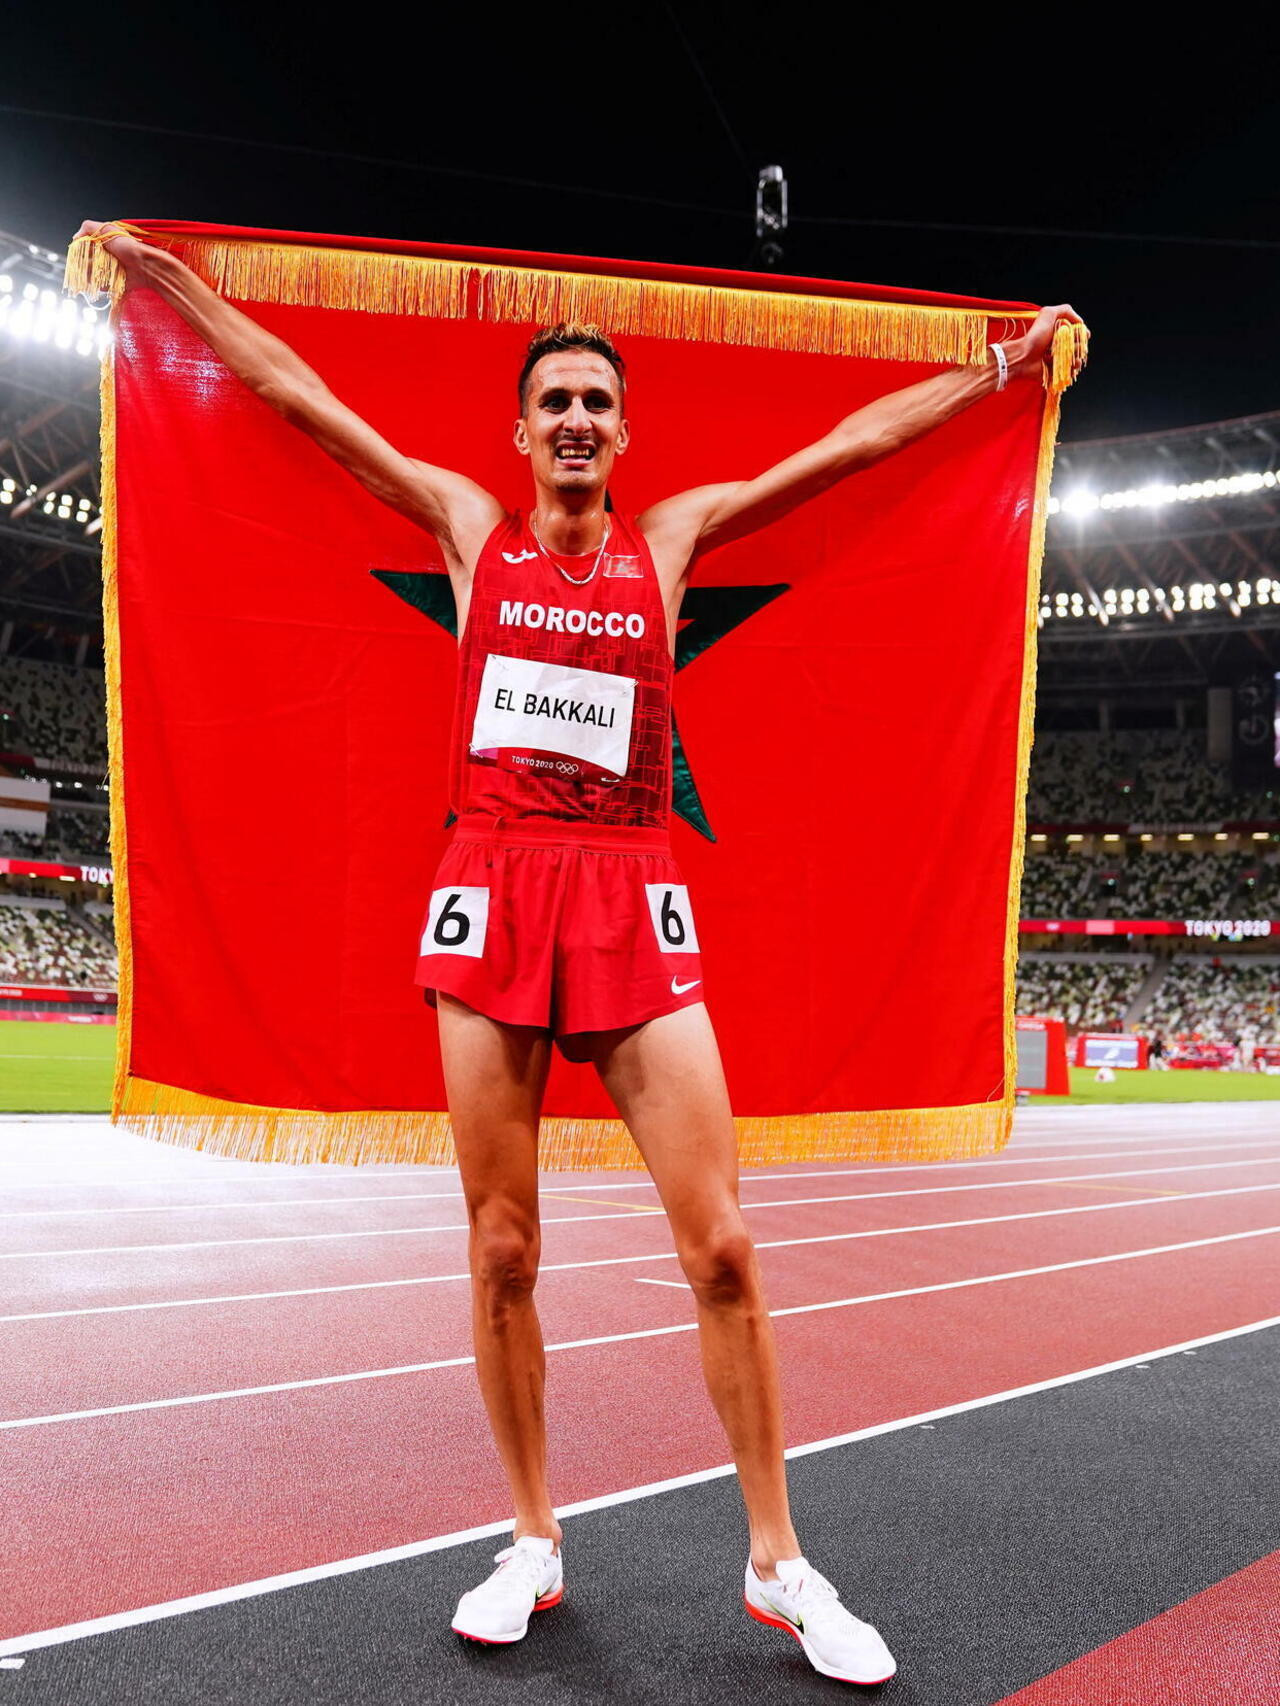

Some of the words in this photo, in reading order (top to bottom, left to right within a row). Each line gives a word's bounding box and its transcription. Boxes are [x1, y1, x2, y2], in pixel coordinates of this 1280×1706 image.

[499, 600, 645, 639] MOROCCO
[494, 688, 516, 712] EL
[523, 693, 616, 728] BAKKALI
[511, 755, 535, 767] TOKYO
[535, 758, 554, 769] 2020
[433, 893, 470, 946] 6
[661, 891, 685, 945] 6
[1185, 920, 1231, 936] TOKYO
[1232, 920, 1271, 936] 2020
